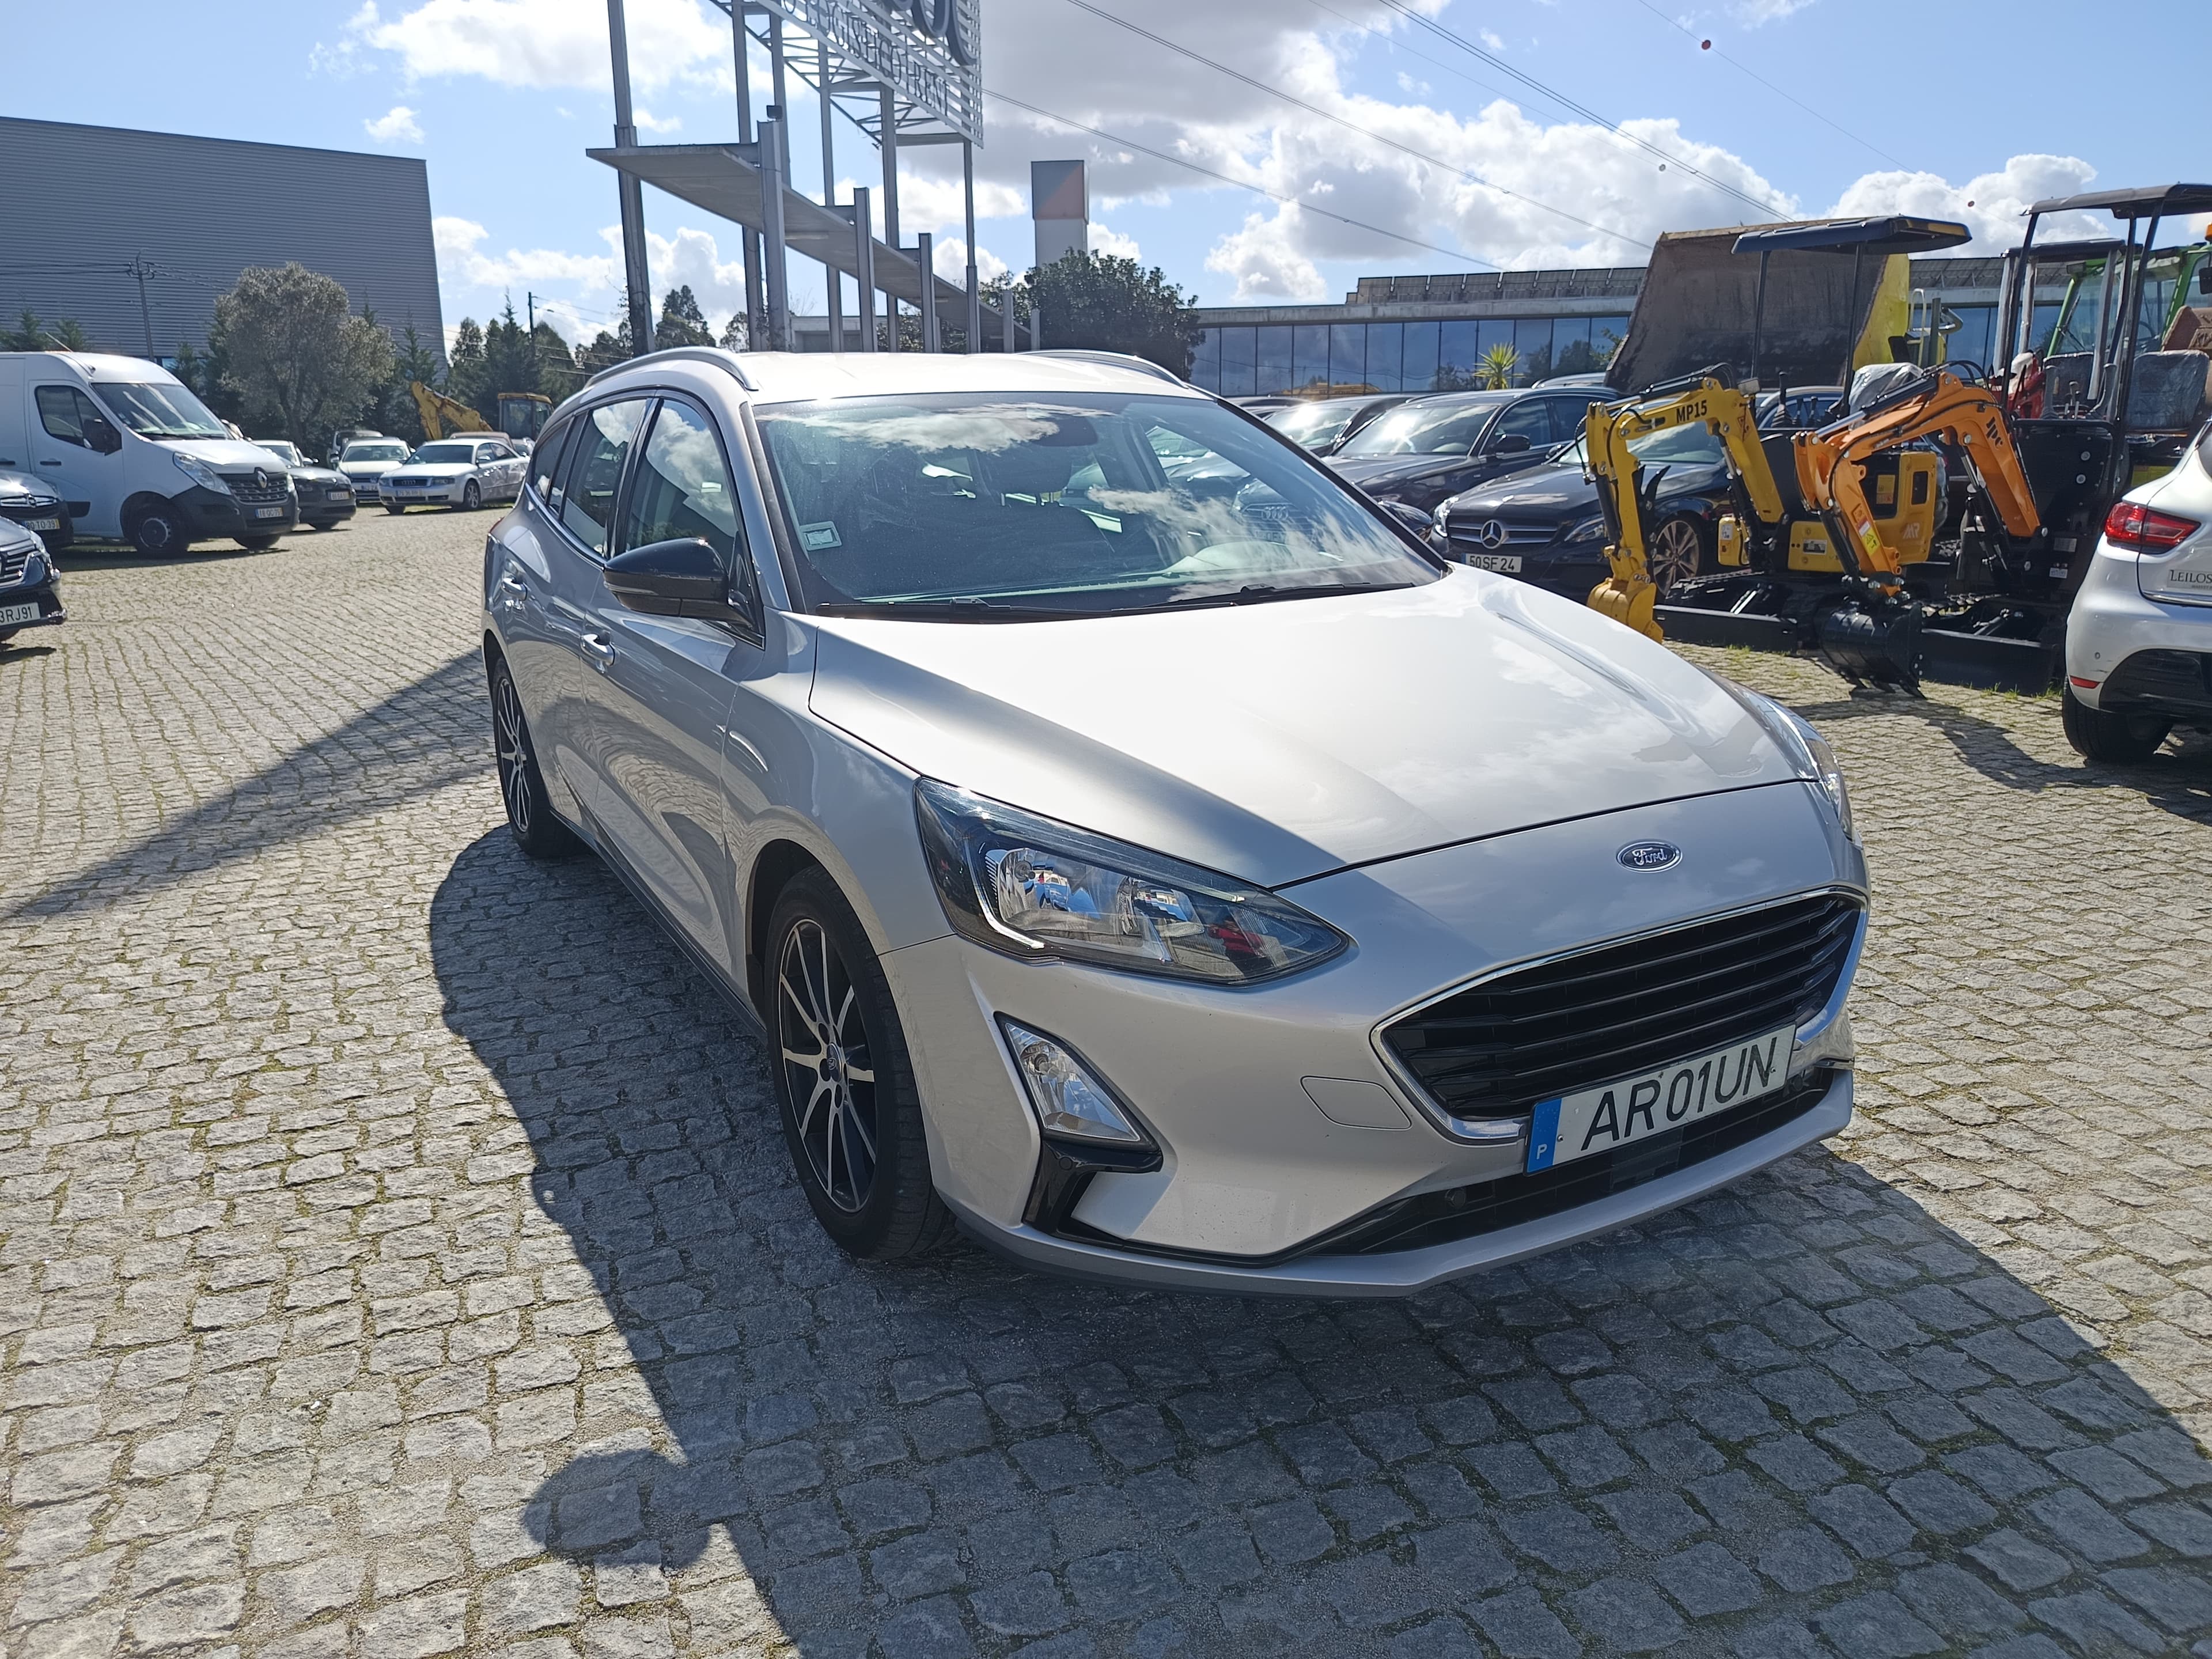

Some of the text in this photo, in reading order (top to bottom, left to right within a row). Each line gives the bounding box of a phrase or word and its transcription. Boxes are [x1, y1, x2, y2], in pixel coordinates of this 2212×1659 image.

[912, 60, 949, 117] RENT
[1676, 399, 1708, 424] MP15
[2169, 569, 2212, 584] LEILOS
[1631, 847, 1668, 866] Ford
[1536, 1143, 1548, 1160] P
